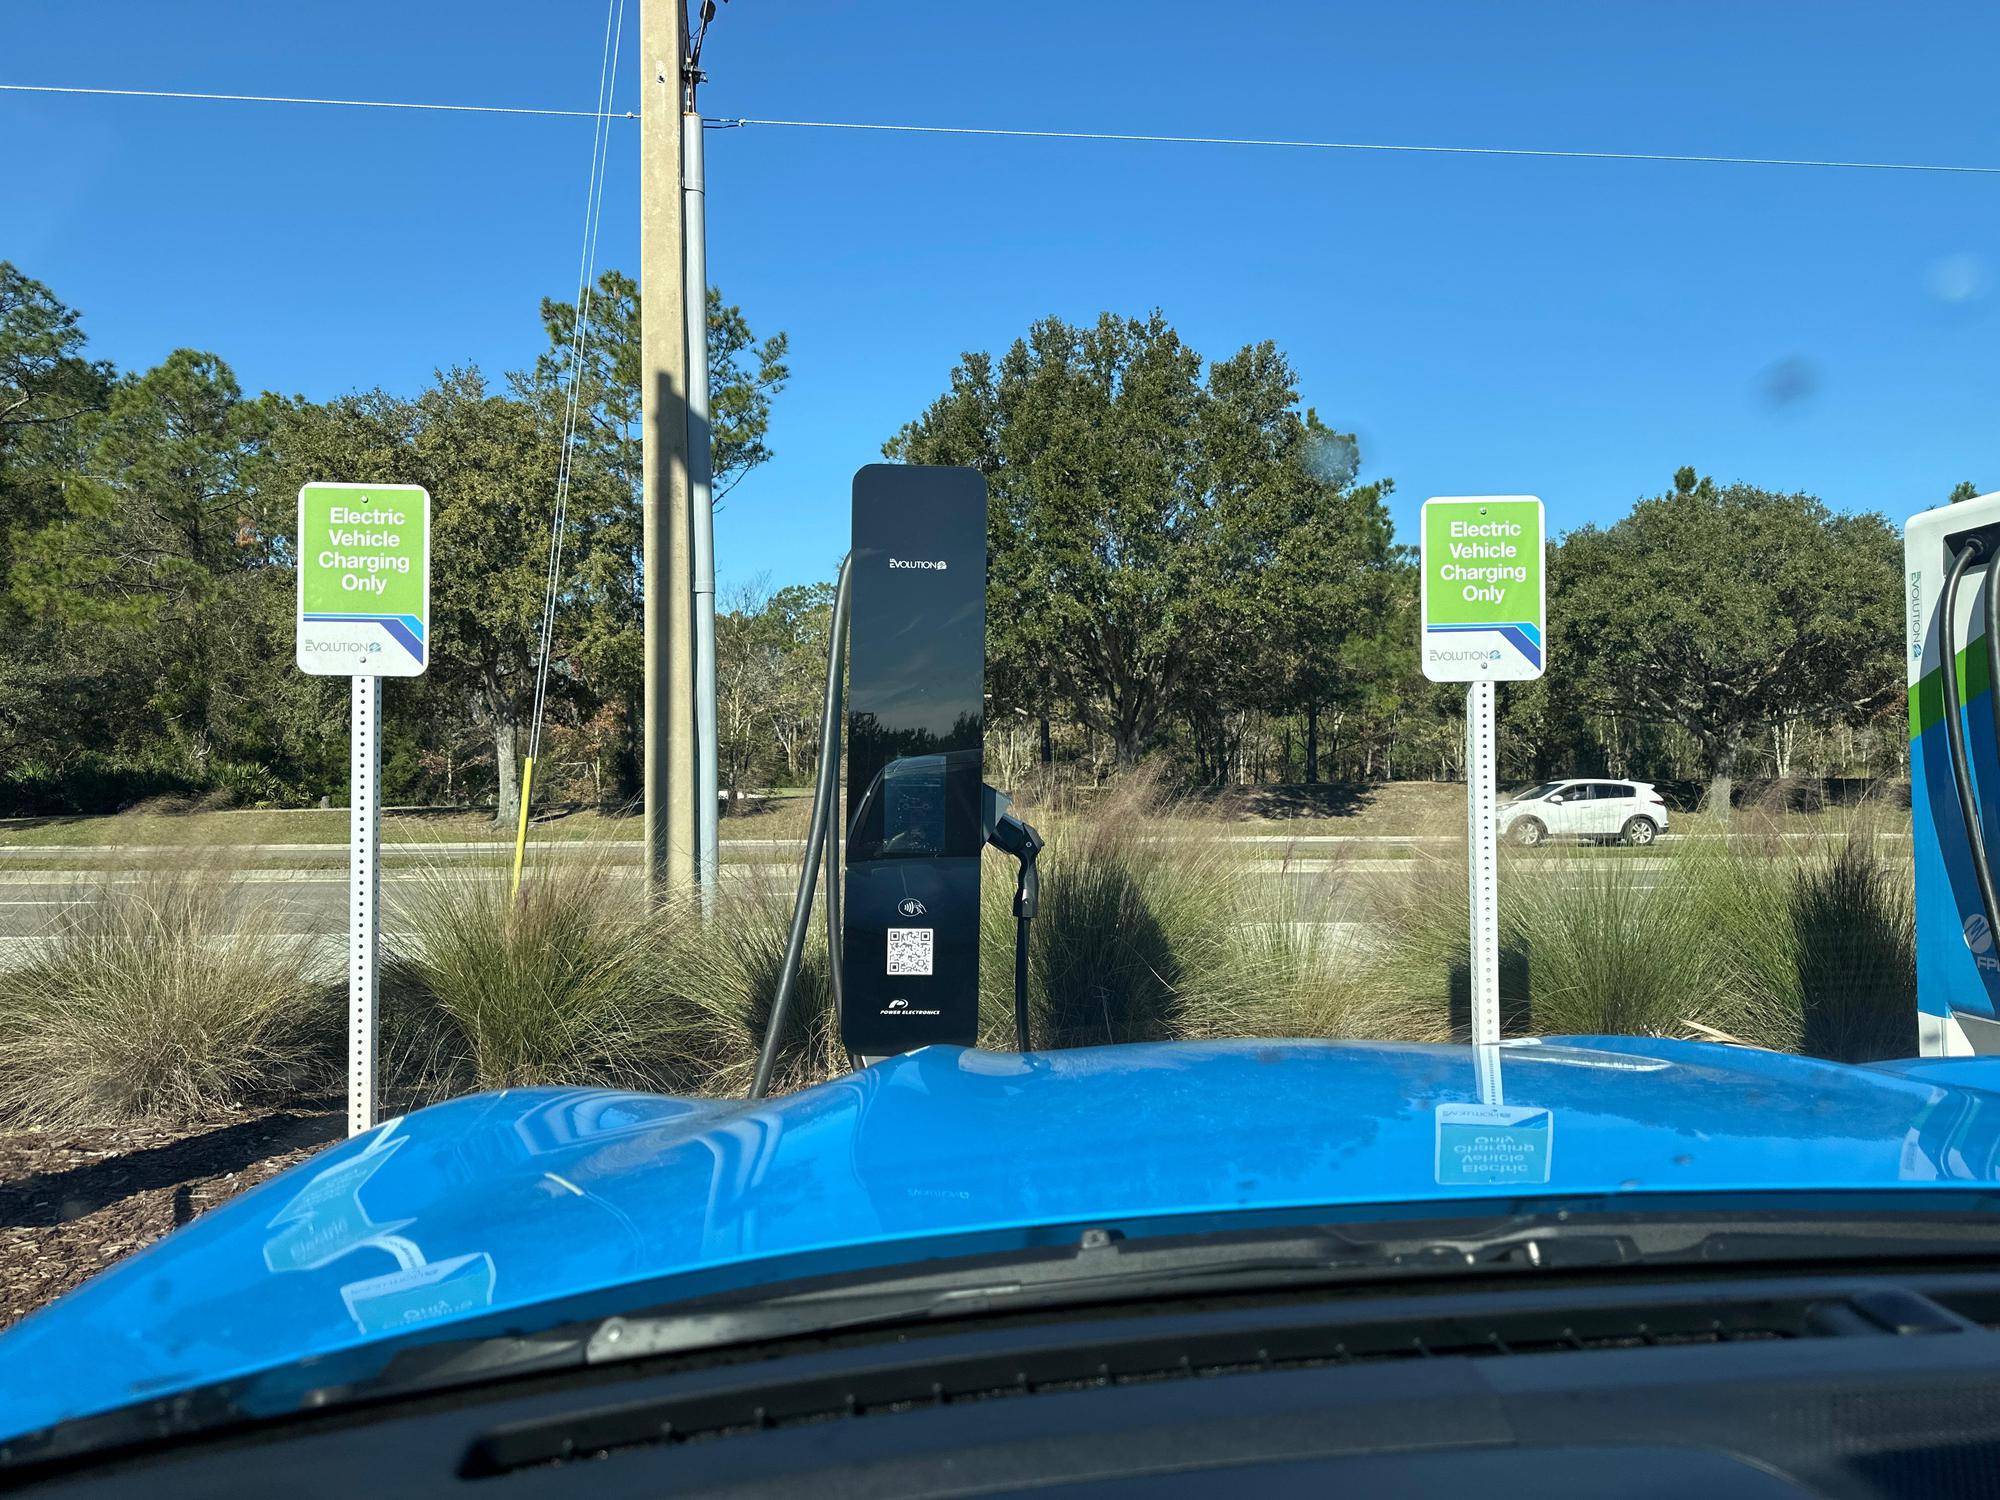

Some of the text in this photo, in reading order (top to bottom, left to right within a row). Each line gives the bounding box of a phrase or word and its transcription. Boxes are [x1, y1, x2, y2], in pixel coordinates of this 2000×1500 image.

[330, 507, 405, 525] Electric
[329, 529, 400, 547] Vehicle
[1450, 521, 1521, 537] Electric
[1449, 542, 1517, 558] Vehicle
[318, 551, 410, 572] Charging
[889, 558, 937, 569] EVOLUTION
[1440, 563, 1527, 582] Charging
[341, 573, 387, 595] Only
[1462, 585, 1505, 604] Only
[1911, 571, 1921, 643] EVOLUTION
[305, 639, 368, 653] EVOLUTION
[1429, 649, 1489, 662] EVOLUTION
